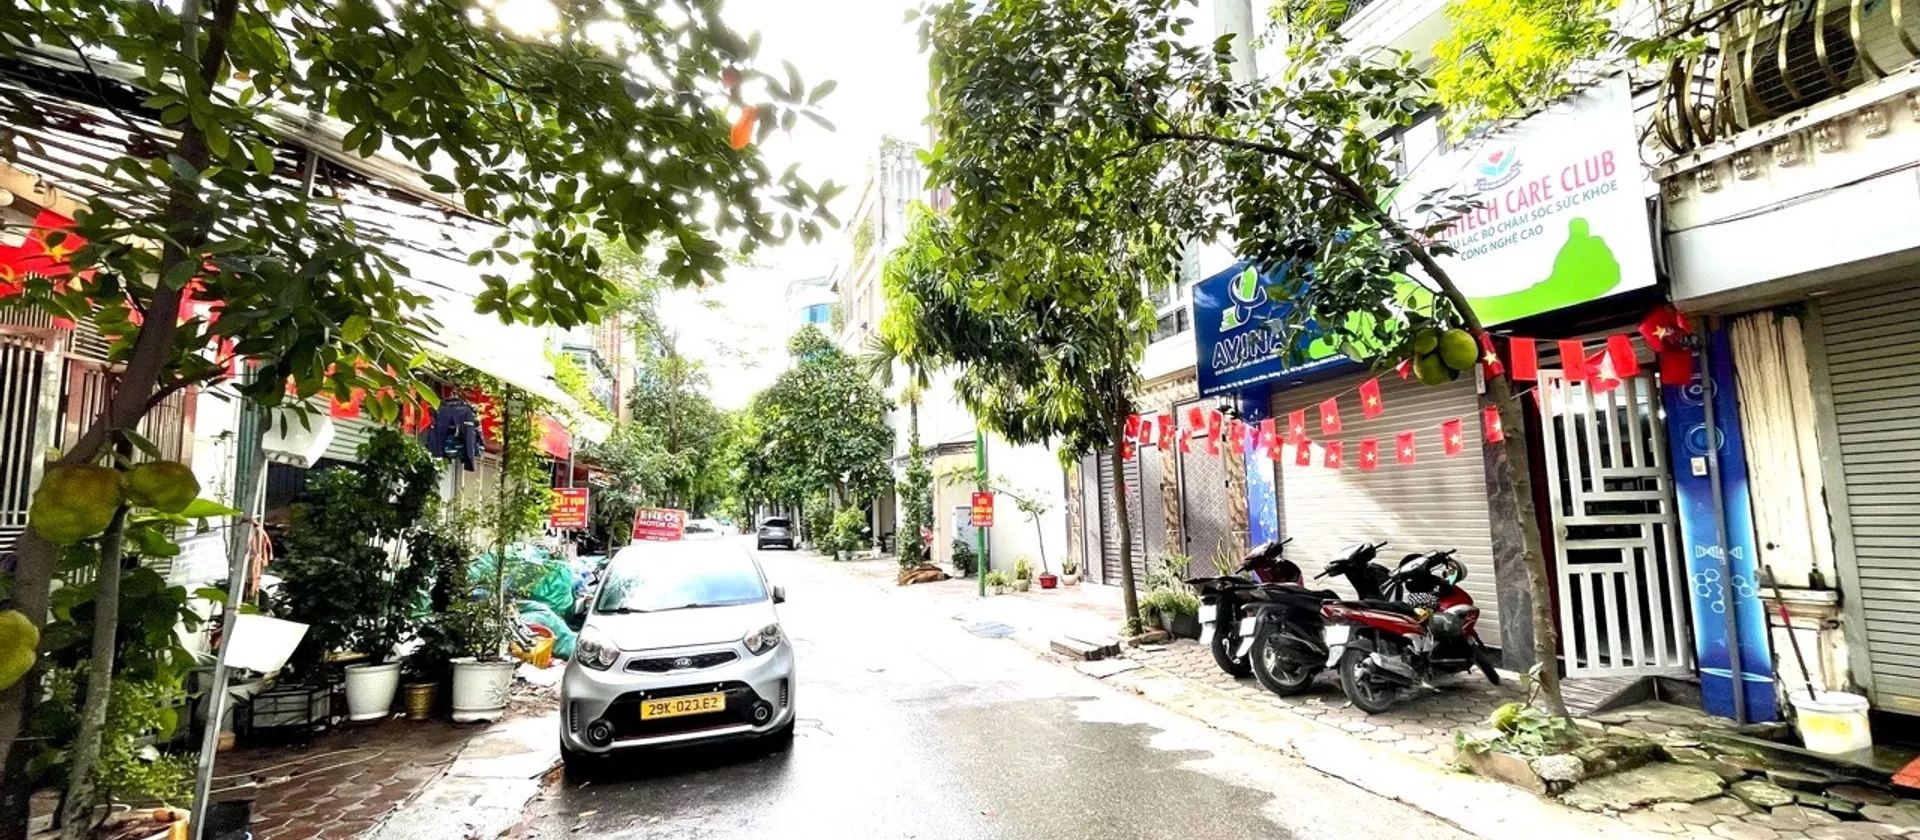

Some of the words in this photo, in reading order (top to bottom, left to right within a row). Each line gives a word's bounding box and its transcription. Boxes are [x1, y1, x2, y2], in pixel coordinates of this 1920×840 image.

[1506, 174, 1553, 213] CARE
[1561, 150, 1615, 191] CLUB
[1520, 224, 1543, 240] CAO
[1212, 328, 1286, 369] AVINA
[639, 519, 666, 528] MOTOR
[640, 510, 681, 523] ENEOS
[675, 659, 691, 667] KIA
[648, 697, 718, 716] 29K-023.62
